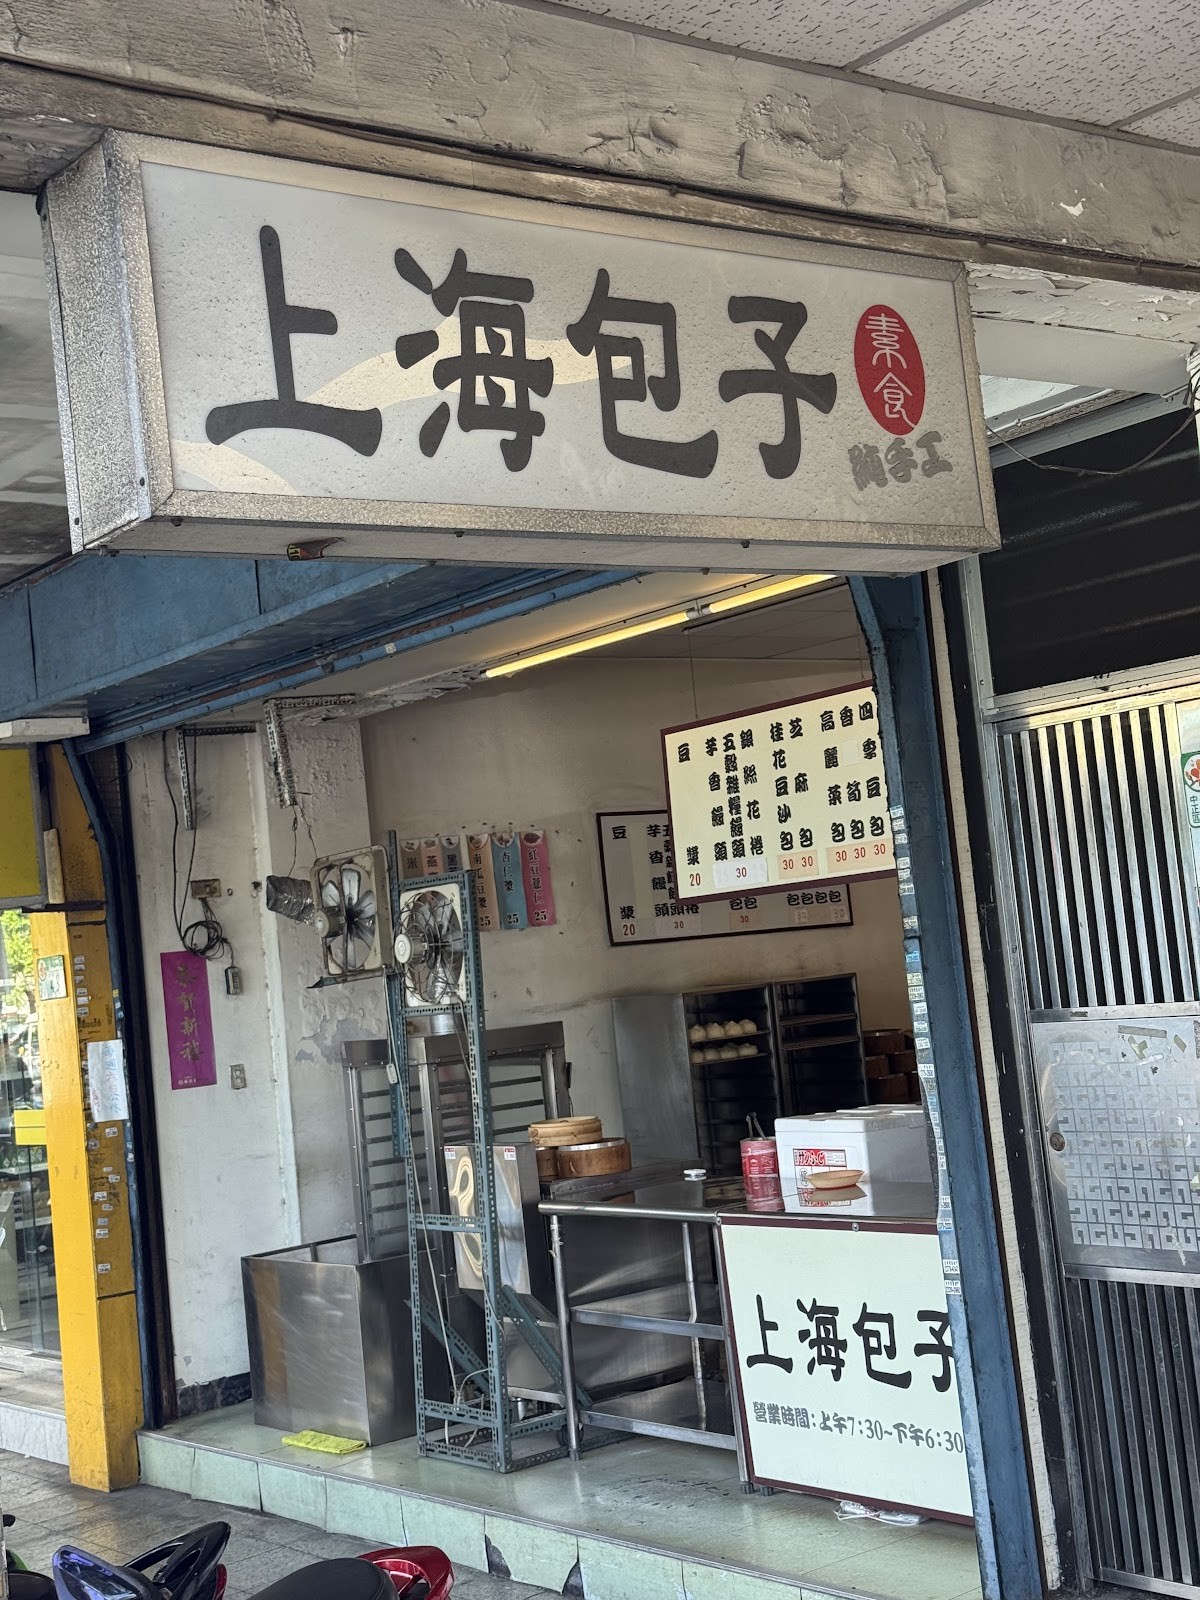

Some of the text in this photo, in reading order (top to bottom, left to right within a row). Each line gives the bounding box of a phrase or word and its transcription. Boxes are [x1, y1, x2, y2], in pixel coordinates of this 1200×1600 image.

[206, 225, 837, 479] 上海包子
[865, 313, 916, 428] 素食
[858, 701, 884, 837] 四季豆包
[769, 721, 793, 851] 桂花豆沙包
[854, 846, 866, 859] 30
[873, 843, 886, 856] 30
[802, 855, 814, 868] 30
[836, 850, 847, 863] 30
[783, 859, 794, 870] 30
[736, 867, 747, 878] 30
[690, 872, 701, 887] 20
[480, 915, 491, 926] 25
[506, 913, 519, 924] 25
[534, 910, 547, 921] 25
[740, 915, 749, 923] 30
[623, 923, 636, 936] 20
[674, 920, 684, 929] 30
[747, 1294, 954, 1393] 上海包子
